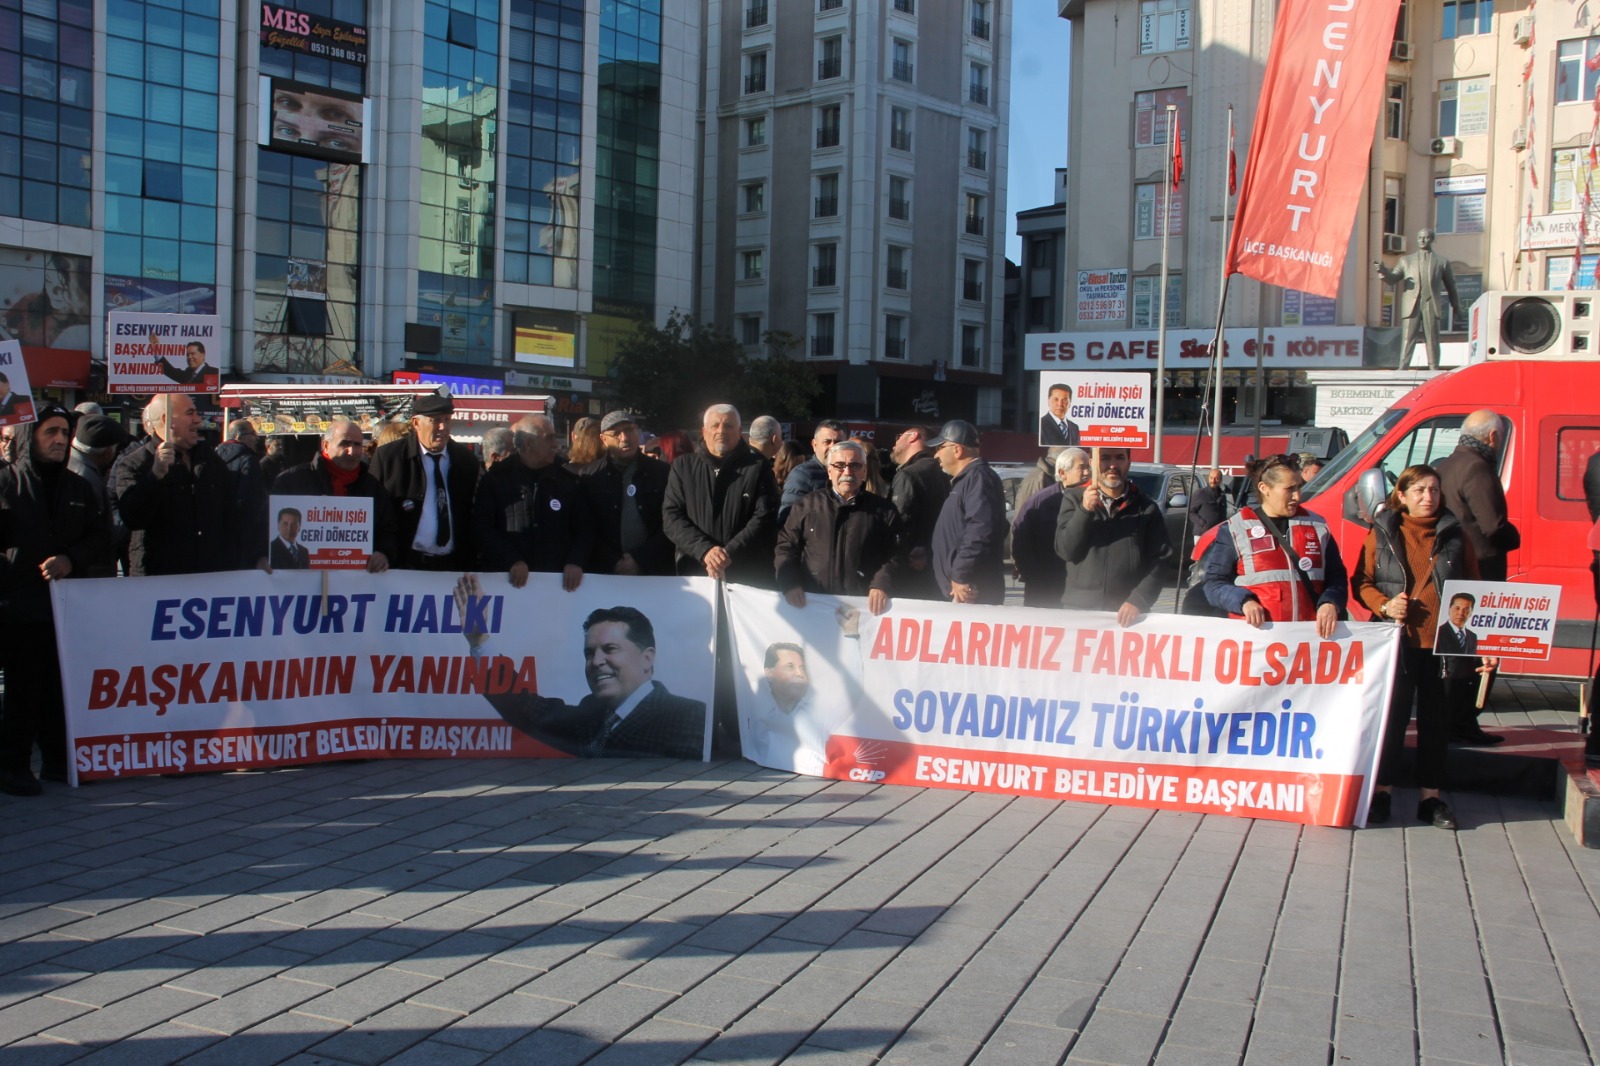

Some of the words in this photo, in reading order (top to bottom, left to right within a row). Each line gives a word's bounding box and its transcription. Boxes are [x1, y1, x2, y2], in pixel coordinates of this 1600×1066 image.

[262, 5, 310, 36] MES
[311, 42, 330, 54] 0531
[331, 47, 344, 58] 368
[347, 50, 355, 60] 05
[358, 53, 366, 62] 21
[1549, 222, 1586, 233] MERK
[1243, 238, 1265, 256] İLÇE
[1268, 244, 1333, 268] BAŞKANLIĞI
[1086, 291, 1118, 300] TAŞIMACILIĞI
[1079, 301, 1094, 310] 0212
[1118, 300, 1125, 309] 31
[1079, 312, 1093, 320] 0532
[116, 323, 178, 336] ESENYURT
[181, 325, 213, 337] HALKI
[114, 343, 186, 357] BAŞKANININ
[1040, 342, 1076, 361] ES
[1086, 340, 1160, 360] CAFE
[1287, 336, 1359, 357] KÖFTE
[113, 363, 164, 375] YANINDA
[396, 378, 502, 395] ANGE
[1077, 383, 1116, 399] BİLİMİN
[1119, 385, 1142, 402] IŞIĞI
[1330, 388, 1395, 398] EGEMENLİK
[473, 411, 509, 422] DÖNER
[1071, 402, 1094, 418] GERİ
[1097, 403, 1145, 419] DÖNECEK
[1330, 406, 1374, 416] ŞARTSIZ
[850, 430, 875, 439] KFC
[307, 507, 343, 523] BİLİMİN
[346, 509, 366, 525] IŞIĞI
[301, 526, 323, 542] GERİ
[326, 526, 369, 542] DÖNECEK
[1480, 592, 1522, 609] BİLİMİN
[1524, 596, 1551, 612] IŞIĞI
[151, 594, 376, 641] ESENYURT
[385, 594, 504, 633] HALKI
[1471, 612, 1497, 628] GERİ
[1498, 613, 1550, 631] DÖNECEK
[870, 617, 1065, 671] ADLARIMIZ
[1072, 628, 1205, 682] FARKLI
[1214, 639, 1364, 686] OLSADA
[88, 656, 356, 716] BAŞKANININ
[370, 655, 539, 694] YANINDA
[892, 688, 1080, 745] SOYADIMIZ
[1091, 691, 1324, 759] TÜRKİYEDİR.
[76, 734, 186, 776] SEÇİLMİŞ
[194, 731, 310, 765] ESENYURT
[316, 718, 414, 756] BELEDİYE
[420, 726, 512, 756] BAŞKANI
[849, 767, 886, 782] CHP
[915, 755, 1048, 791] ESENYURT
[1054, 767, 1179, 802] BELEDİYE
[1186, 778, 1304, 812] BAŞKANI
